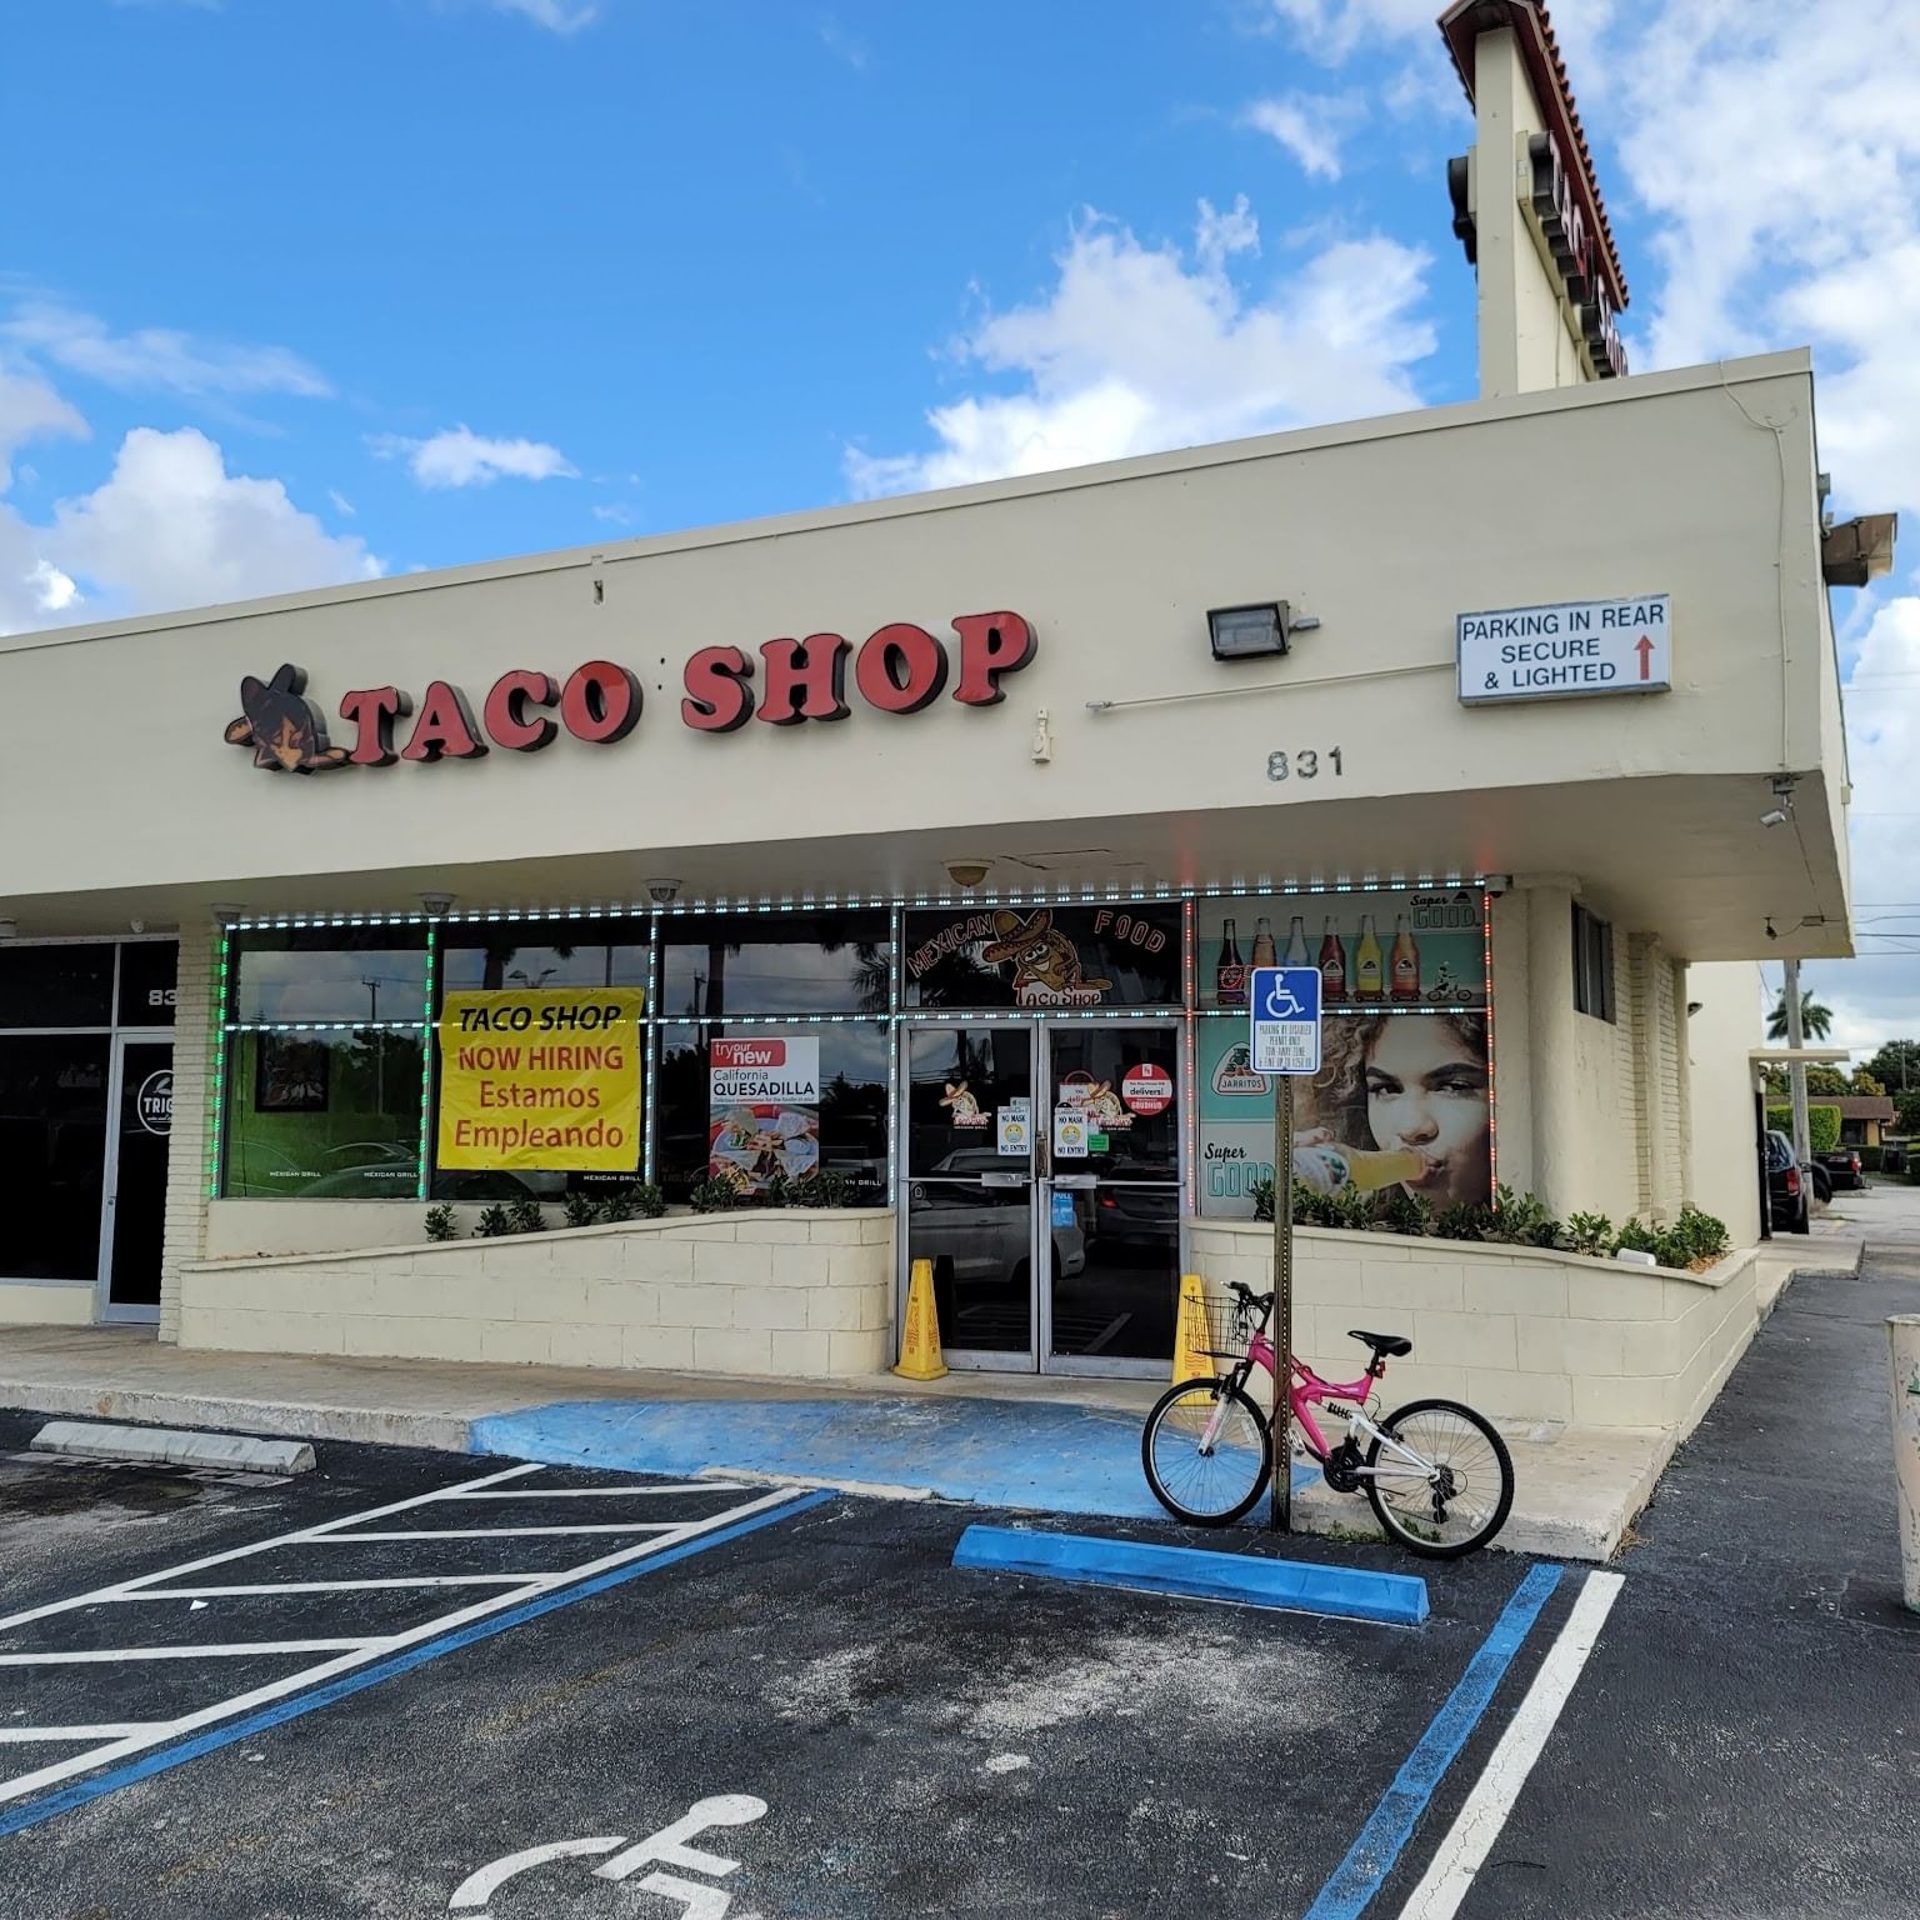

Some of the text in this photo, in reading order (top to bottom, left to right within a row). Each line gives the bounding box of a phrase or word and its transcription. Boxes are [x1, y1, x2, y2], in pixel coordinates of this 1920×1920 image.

[1463, 604, 1664, 640] PARKING IN REAR
[1501, 638, 1600, 664] SECURE
[1484, 662, 1616, 689] & LIGHTED
[340, 609, 1038, 766] TACO SHOP
[1267, 746, 1344, 782] 831
[1410, 894, 1448, 908] Super
[906, 909, 1166, 979] MEXICAN FOOD
[459, 1005, 622, 1032] TACO SHOP
[459, 1045, 624, 1071] NOW HIRING
[715, 1042, 752, 1059] try our
[733, 1051, 772, 1065] new
[713, 1068, 769, 1081] California
[713, 1081, 816, 1096] QUESADILLA
[1222, 1079, 1262, 1089] JARRITOS
[480, 1080, 601, 1108] Estamos
[1011, 1114, 1026, 1123] MASK
[1068, 1116, 1084, 1124] MASK
[455, 1118, 624, 1155] Empleando
[1010, 1144, 1028, 1152] ENTRY
[1067, 1146, 1085, 1155] ENTRY
[1204, 1142, 1247, 1162] Super
[619, 1174, 642, 1182] GRILL
